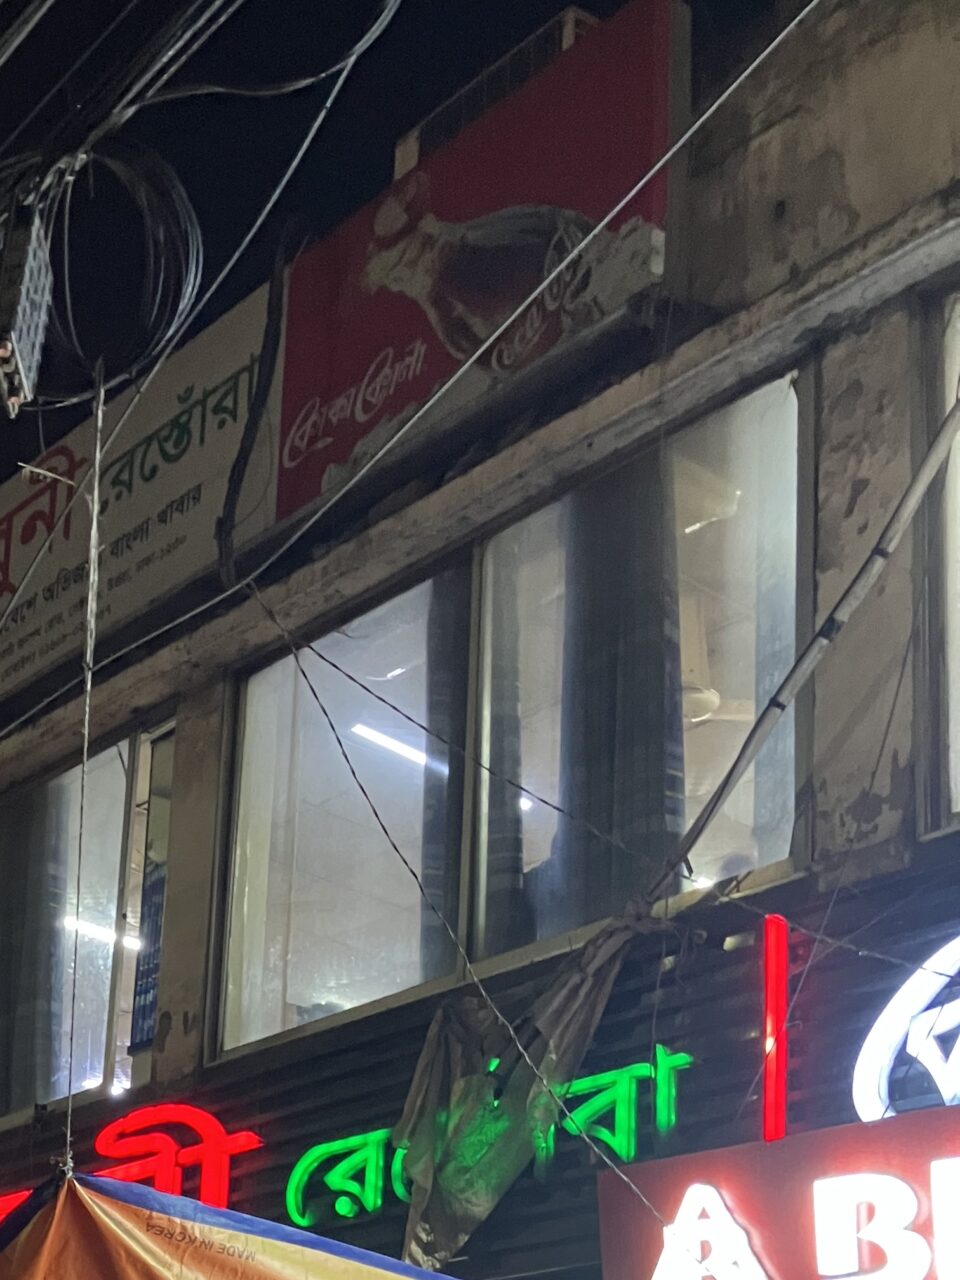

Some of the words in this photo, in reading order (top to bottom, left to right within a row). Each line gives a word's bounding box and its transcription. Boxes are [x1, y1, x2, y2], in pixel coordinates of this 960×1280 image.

[146, 1222, 197, 1246] KOREA
[199, 1238, 214, 1250] IN
[217, 1242, 256, 1262] MADE
